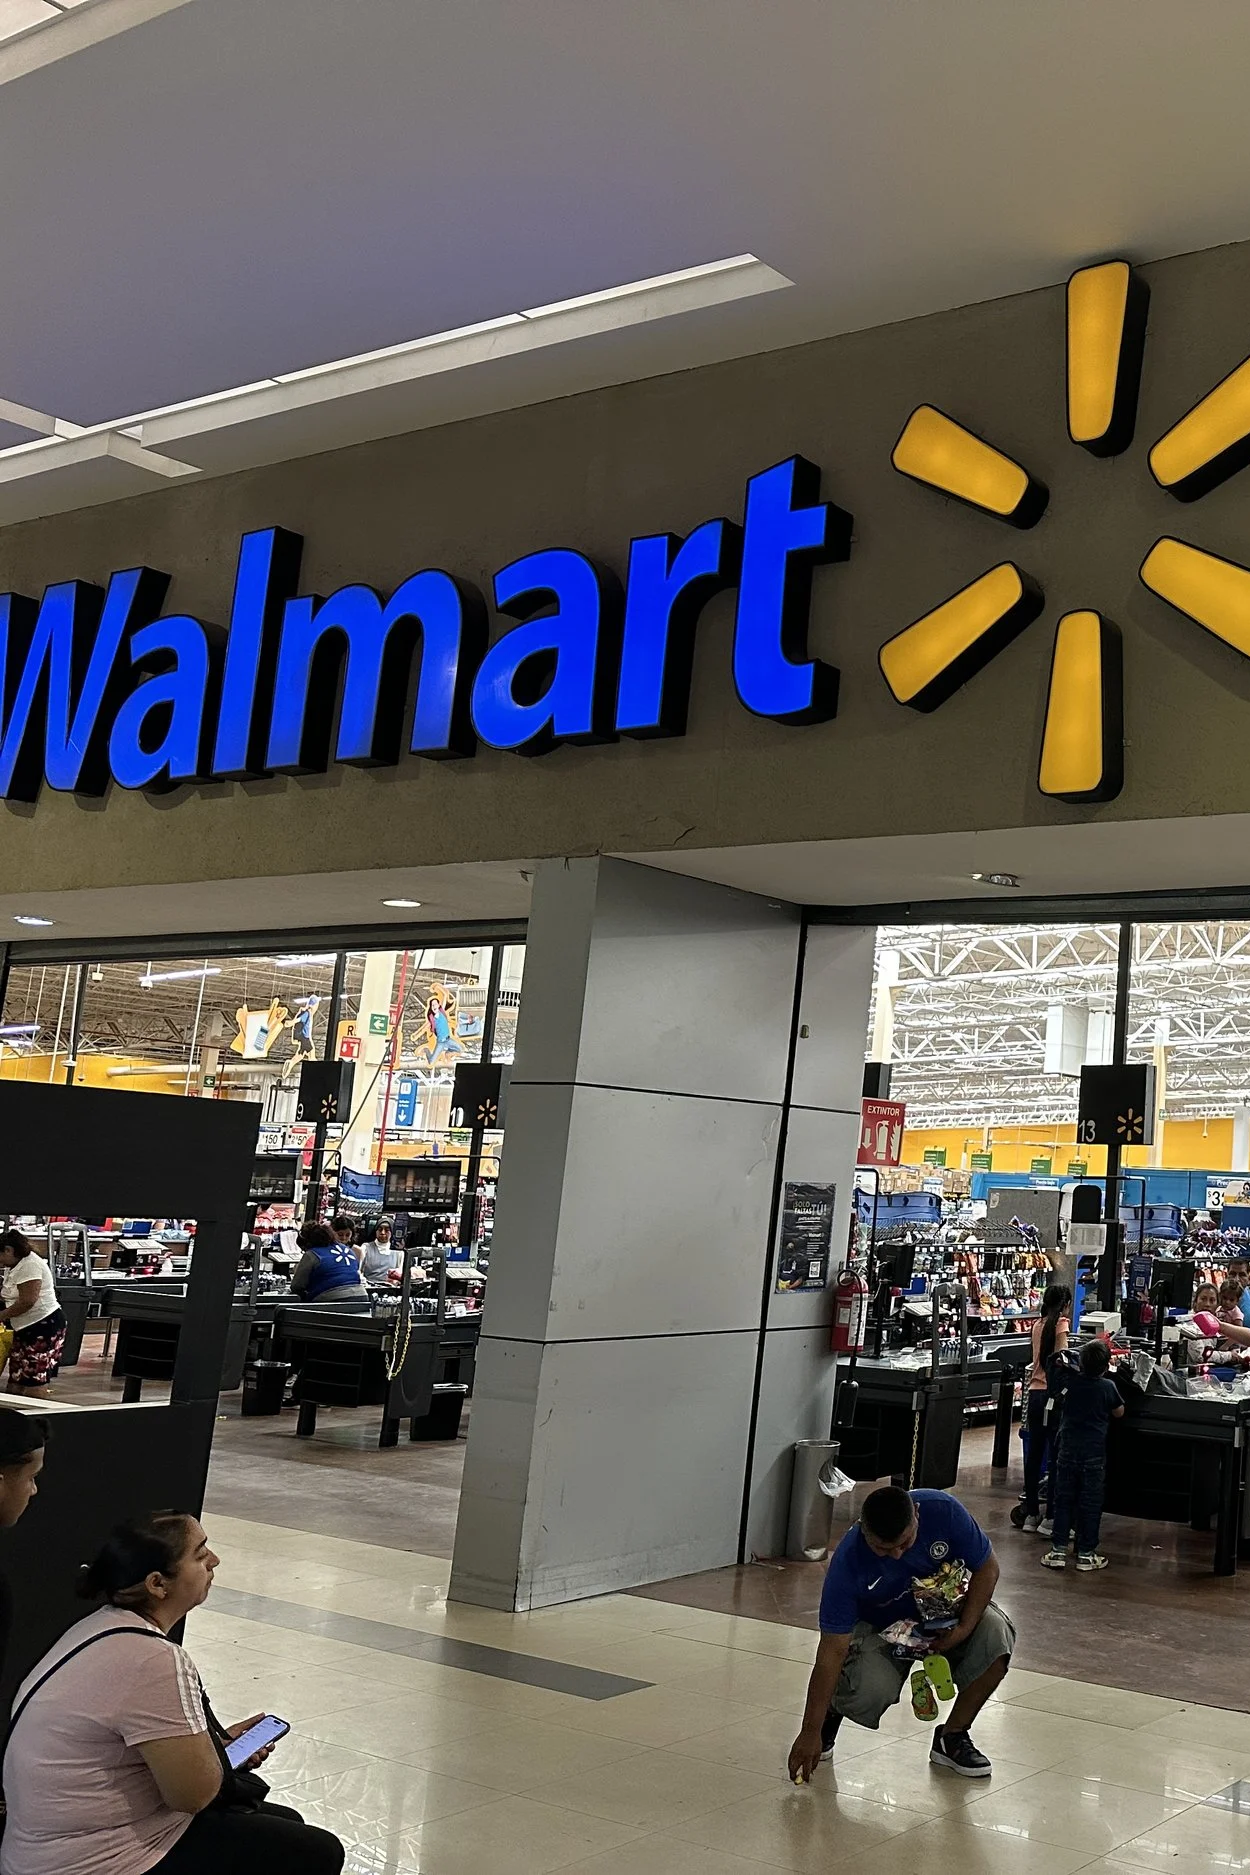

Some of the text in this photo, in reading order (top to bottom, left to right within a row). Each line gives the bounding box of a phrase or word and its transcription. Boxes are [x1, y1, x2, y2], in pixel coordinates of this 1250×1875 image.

[0, 454, 832, 800] Walmart
[296, 1102, 304, 1121] 9
[450, 1106, 464, 1128] 10
[867, 1105, 900, 1116] EXTINTOR
[1078, 1119, 1097, 1143] 13
[811, 1200, 827, 1216] TÚ!
